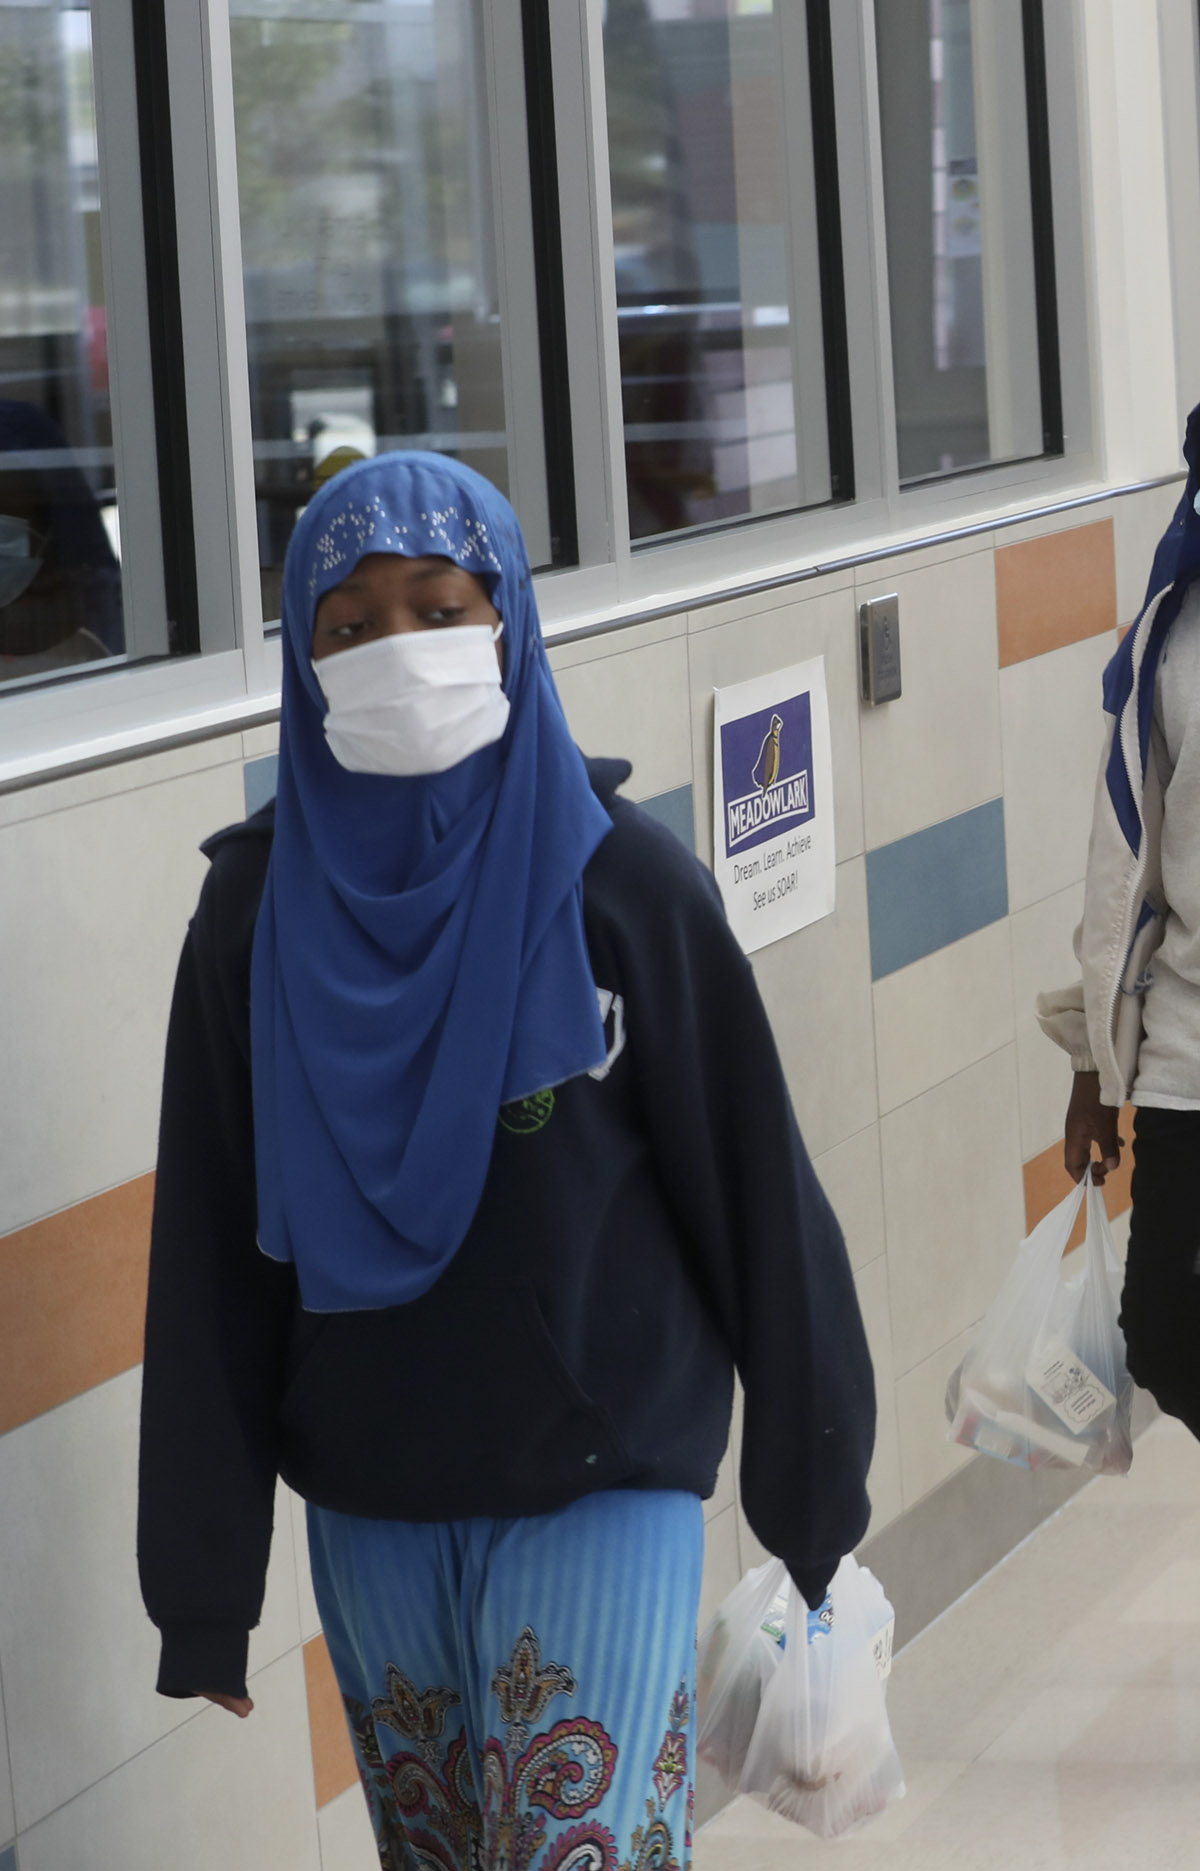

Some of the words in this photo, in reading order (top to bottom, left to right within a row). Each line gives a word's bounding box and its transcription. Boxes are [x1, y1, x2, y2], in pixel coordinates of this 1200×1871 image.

[730, 776, 807, 839] MEADOWLARK
[733, 862, 762, 885] Dream.
[763, 848, 785, 872] Learn.
[753, 889, 767, 911] See
[767, 886, 777, 904] us
[776, 870, 799, 900] SOAR!
